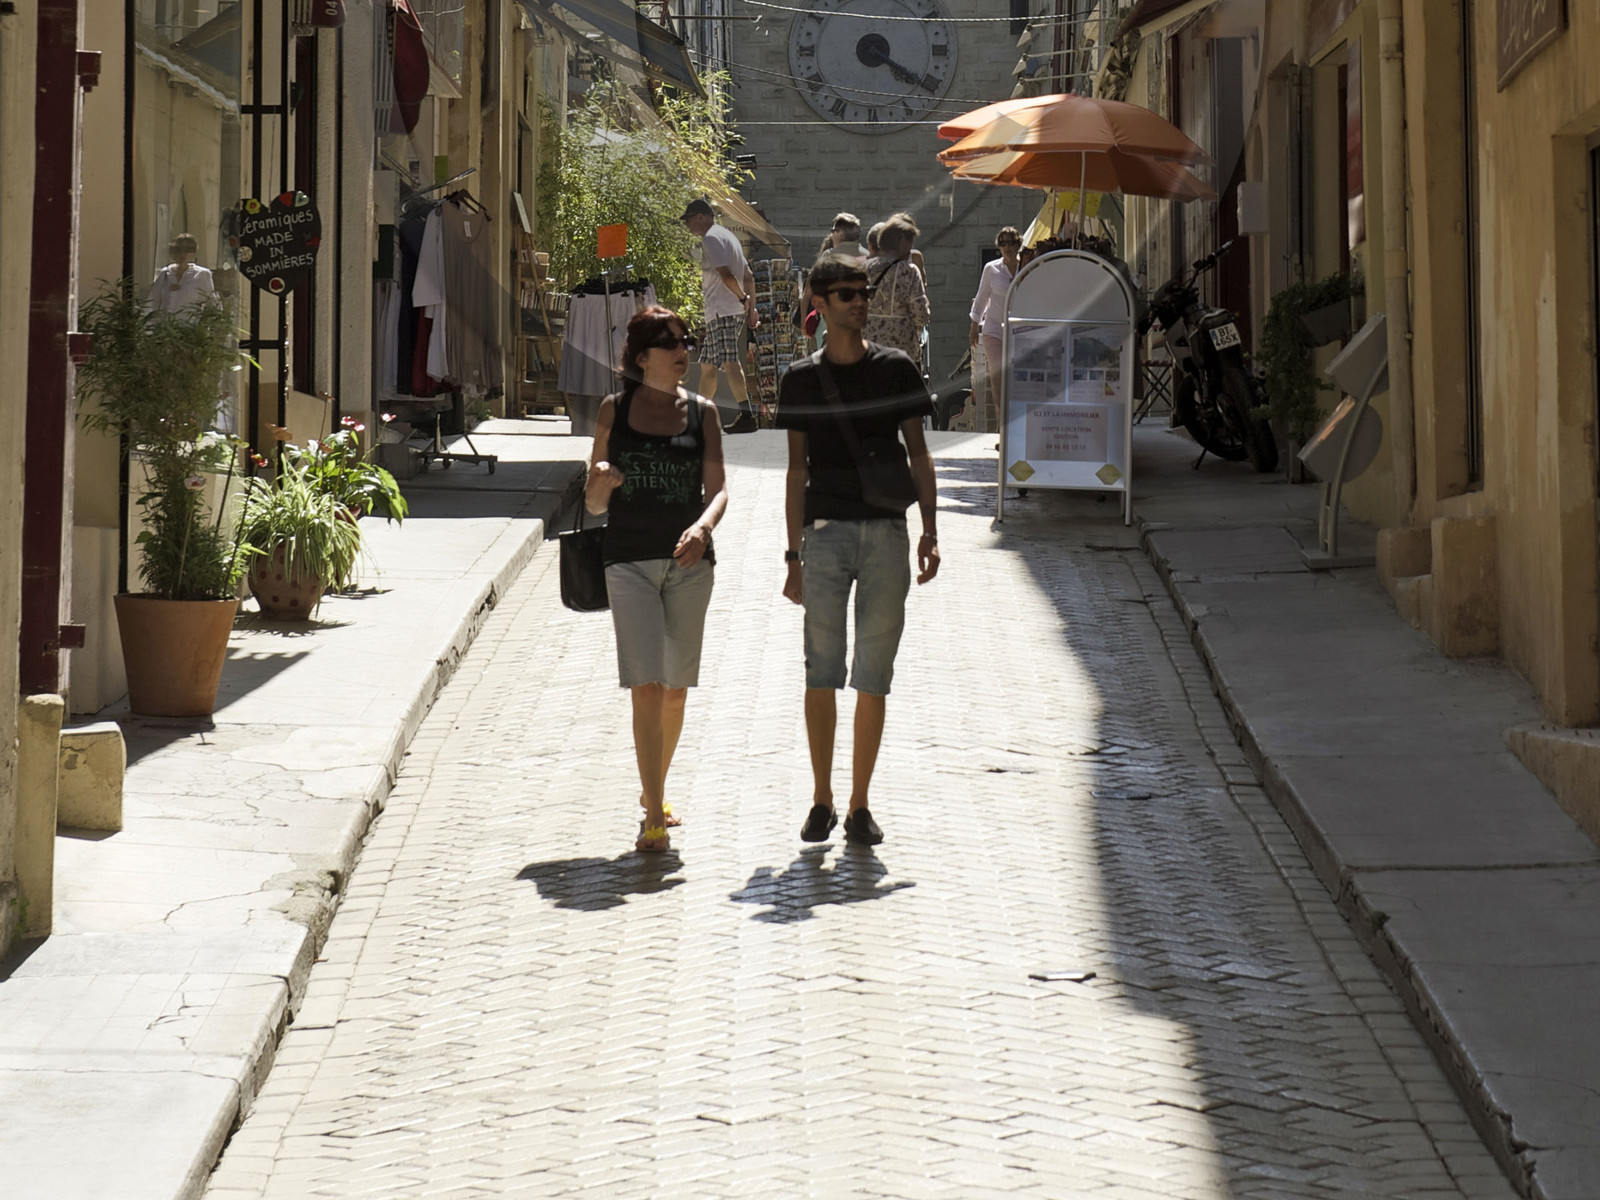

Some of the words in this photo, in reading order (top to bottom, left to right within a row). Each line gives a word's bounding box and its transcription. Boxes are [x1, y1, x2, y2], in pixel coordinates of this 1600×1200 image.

[254, 231, 294, 248] MADE
[268, 246, 285, 258] IN
[650, 460, 687, 475] SAINT
